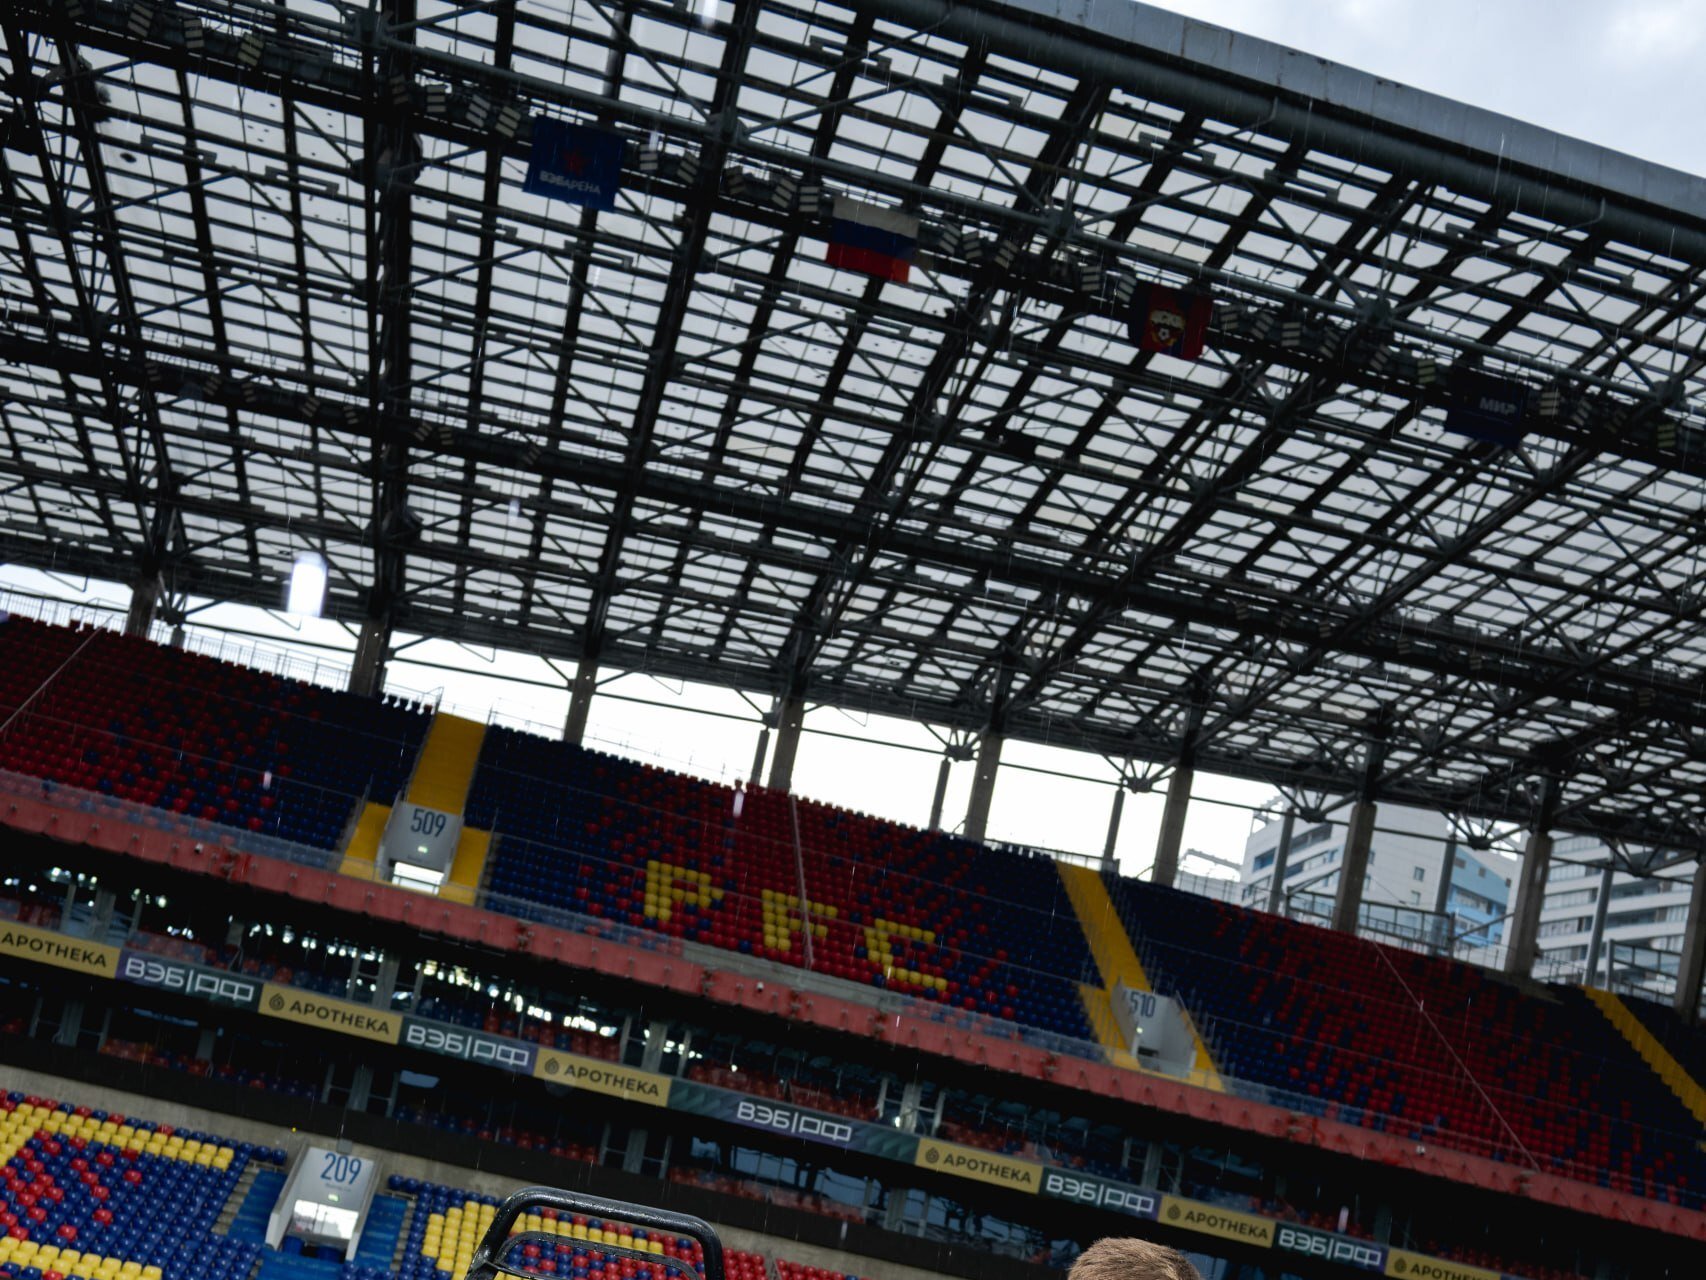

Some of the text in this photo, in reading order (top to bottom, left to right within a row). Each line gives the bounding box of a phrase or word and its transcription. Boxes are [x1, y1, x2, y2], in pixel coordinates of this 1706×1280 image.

[410, 808, 446, 837] 509
[2, 932, 107, 968] APOTHEKA
[289, 1001, 390, 1035] APOTHEKA
[1128, 991, 1156, 1018] 510
[564, 1063, 660, 1097] APOTHEKA
[320, 1152, 362, 1185] 209
[943, 1153, 1032, 1185] APOTHEKA
[1184, 1210, 1269, 1241] APOTHEKA
